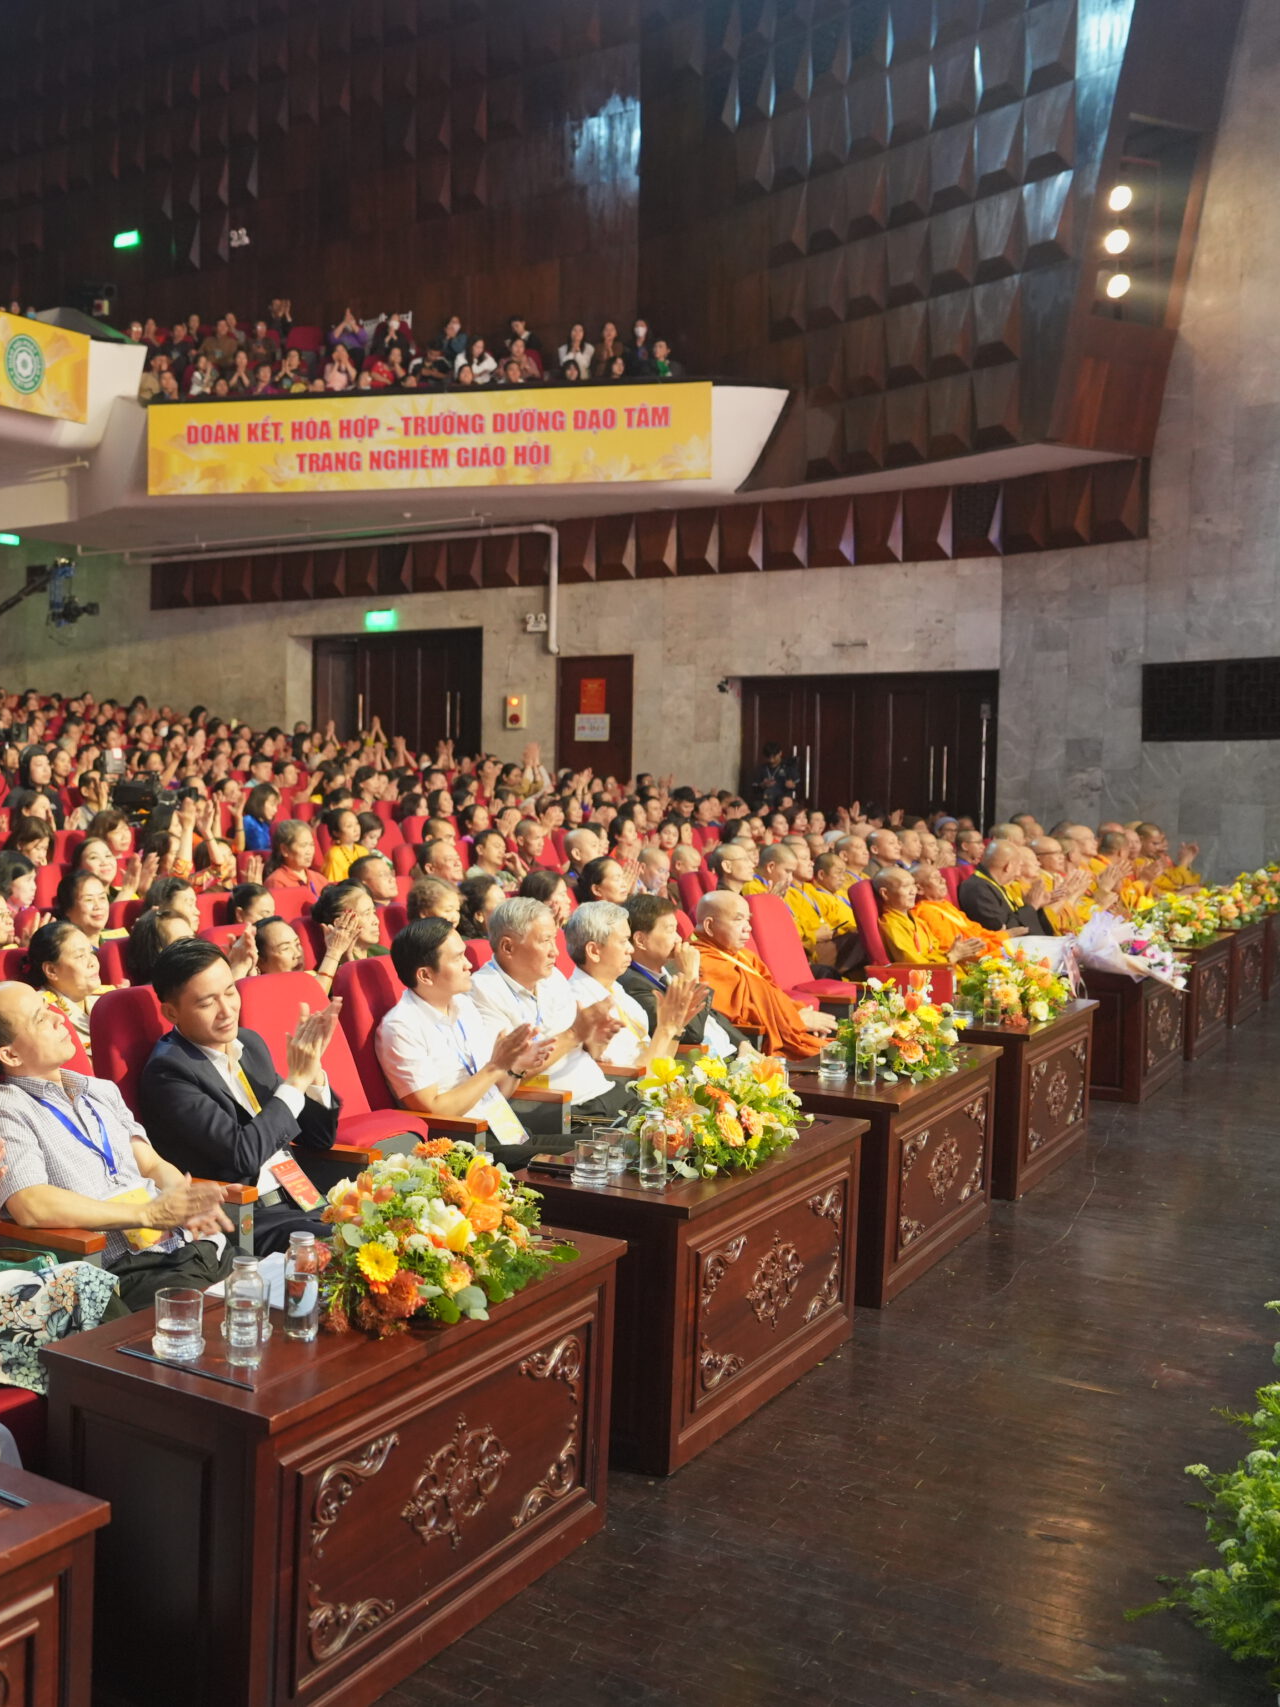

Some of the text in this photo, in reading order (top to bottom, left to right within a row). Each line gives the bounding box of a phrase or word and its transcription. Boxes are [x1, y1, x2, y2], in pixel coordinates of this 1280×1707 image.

[291, 418, 332, 441] HÒA
[339, 415, 380, 442] HỢP
[401, 410, 485, 436] TRƯỜNG
[492, 408, 566, 433] DƯỠNG
[573, 408, 616, 434] ĐẠO
[624, 403, 670, 428] TÂM
[296, 442, 551, 473] TRANG NGHIÊM GIÁO HỘI
